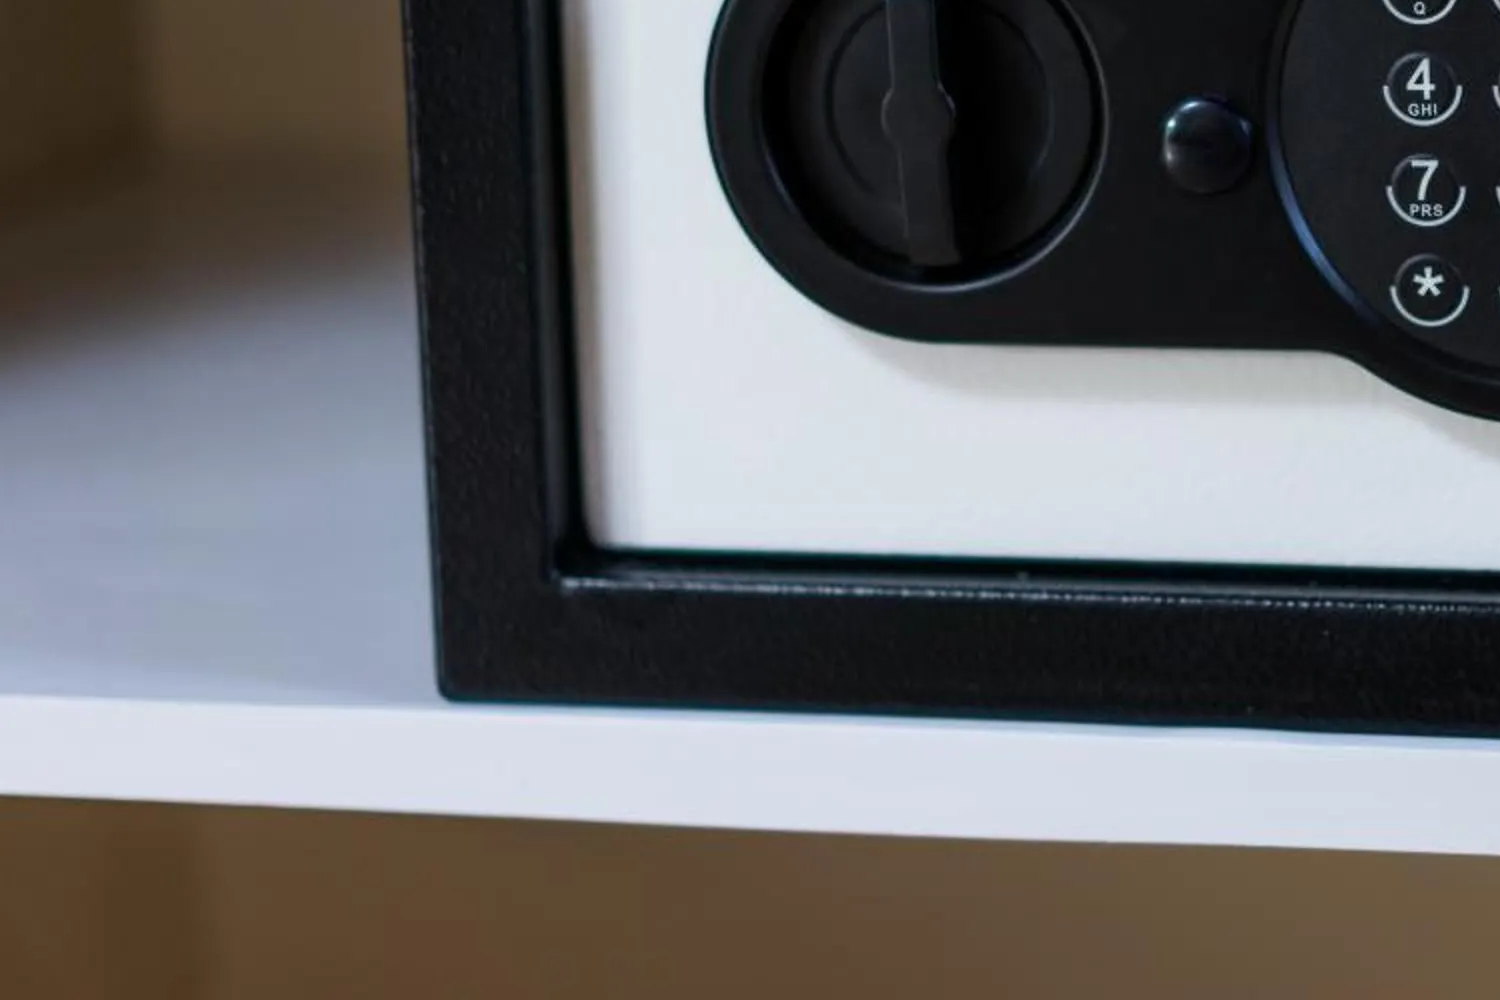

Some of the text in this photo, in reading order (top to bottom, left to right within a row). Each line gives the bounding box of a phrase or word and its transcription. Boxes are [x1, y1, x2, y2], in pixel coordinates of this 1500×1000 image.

[1413, 1, 1426, 15] Q
[1406, 57, 1436, 100] 4
[1407, 103, 1437, 117] GHI
[1410, 159, 1439, 201] 7
[1409, 203, 1443, 217] PRS
